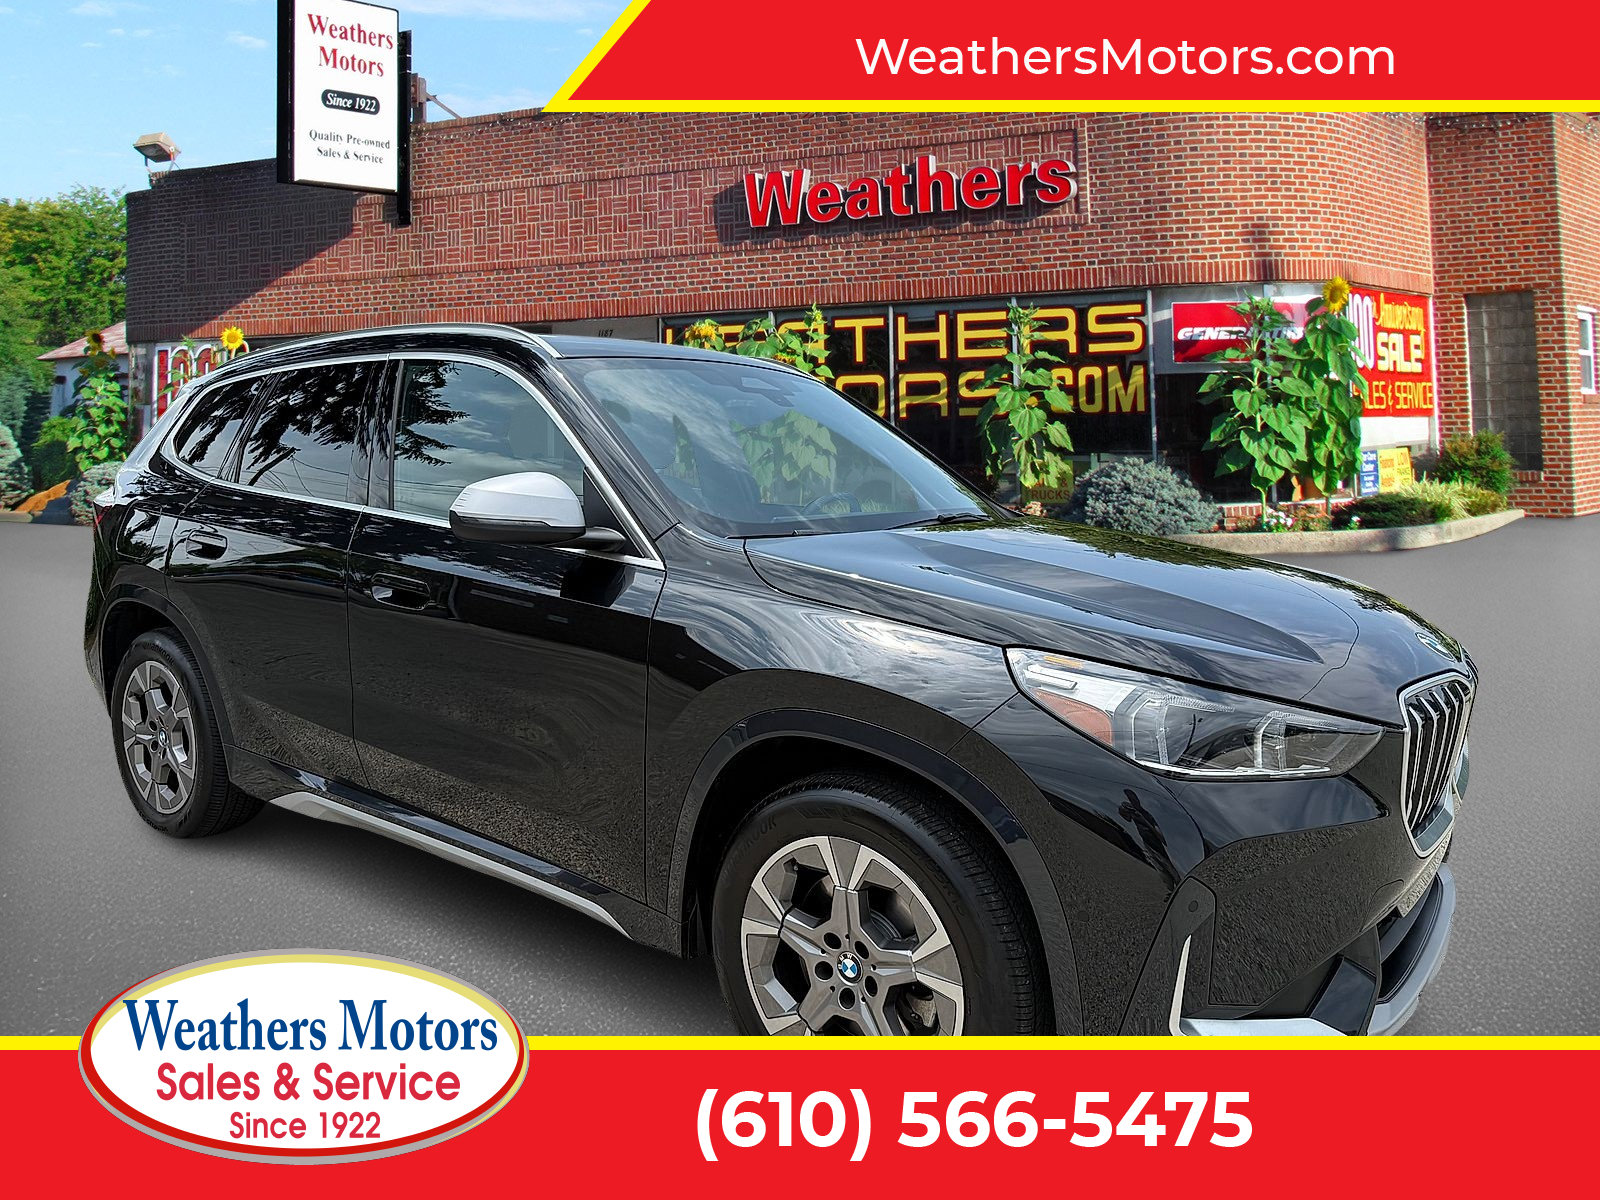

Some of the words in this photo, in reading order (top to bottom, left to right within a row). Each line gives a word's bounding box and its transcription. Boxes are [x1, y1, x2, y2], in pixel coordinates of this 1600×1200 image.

[307, 13, 393, 50] Weathers
[319, 45, 384, 77] Motors
[326, 93, 353, 108] Since
[355, 97, 376, 112] 1922
[309, 129, 343, 145] Quality
[346, 133, 390, 150] Pre-owned
[317, 146, 341, 158] Sales
[343, 149, 350, 160] &
[353, 151, 383, 164] Service
[744, 155, 1077, 227] Weathers
[598, 329, 614, 338] 1187
[1377, 332, 1422, 372] SALE
[1353, 381, 1386, 409] LES
[1395, 381, 1434, 409] SERVICE
